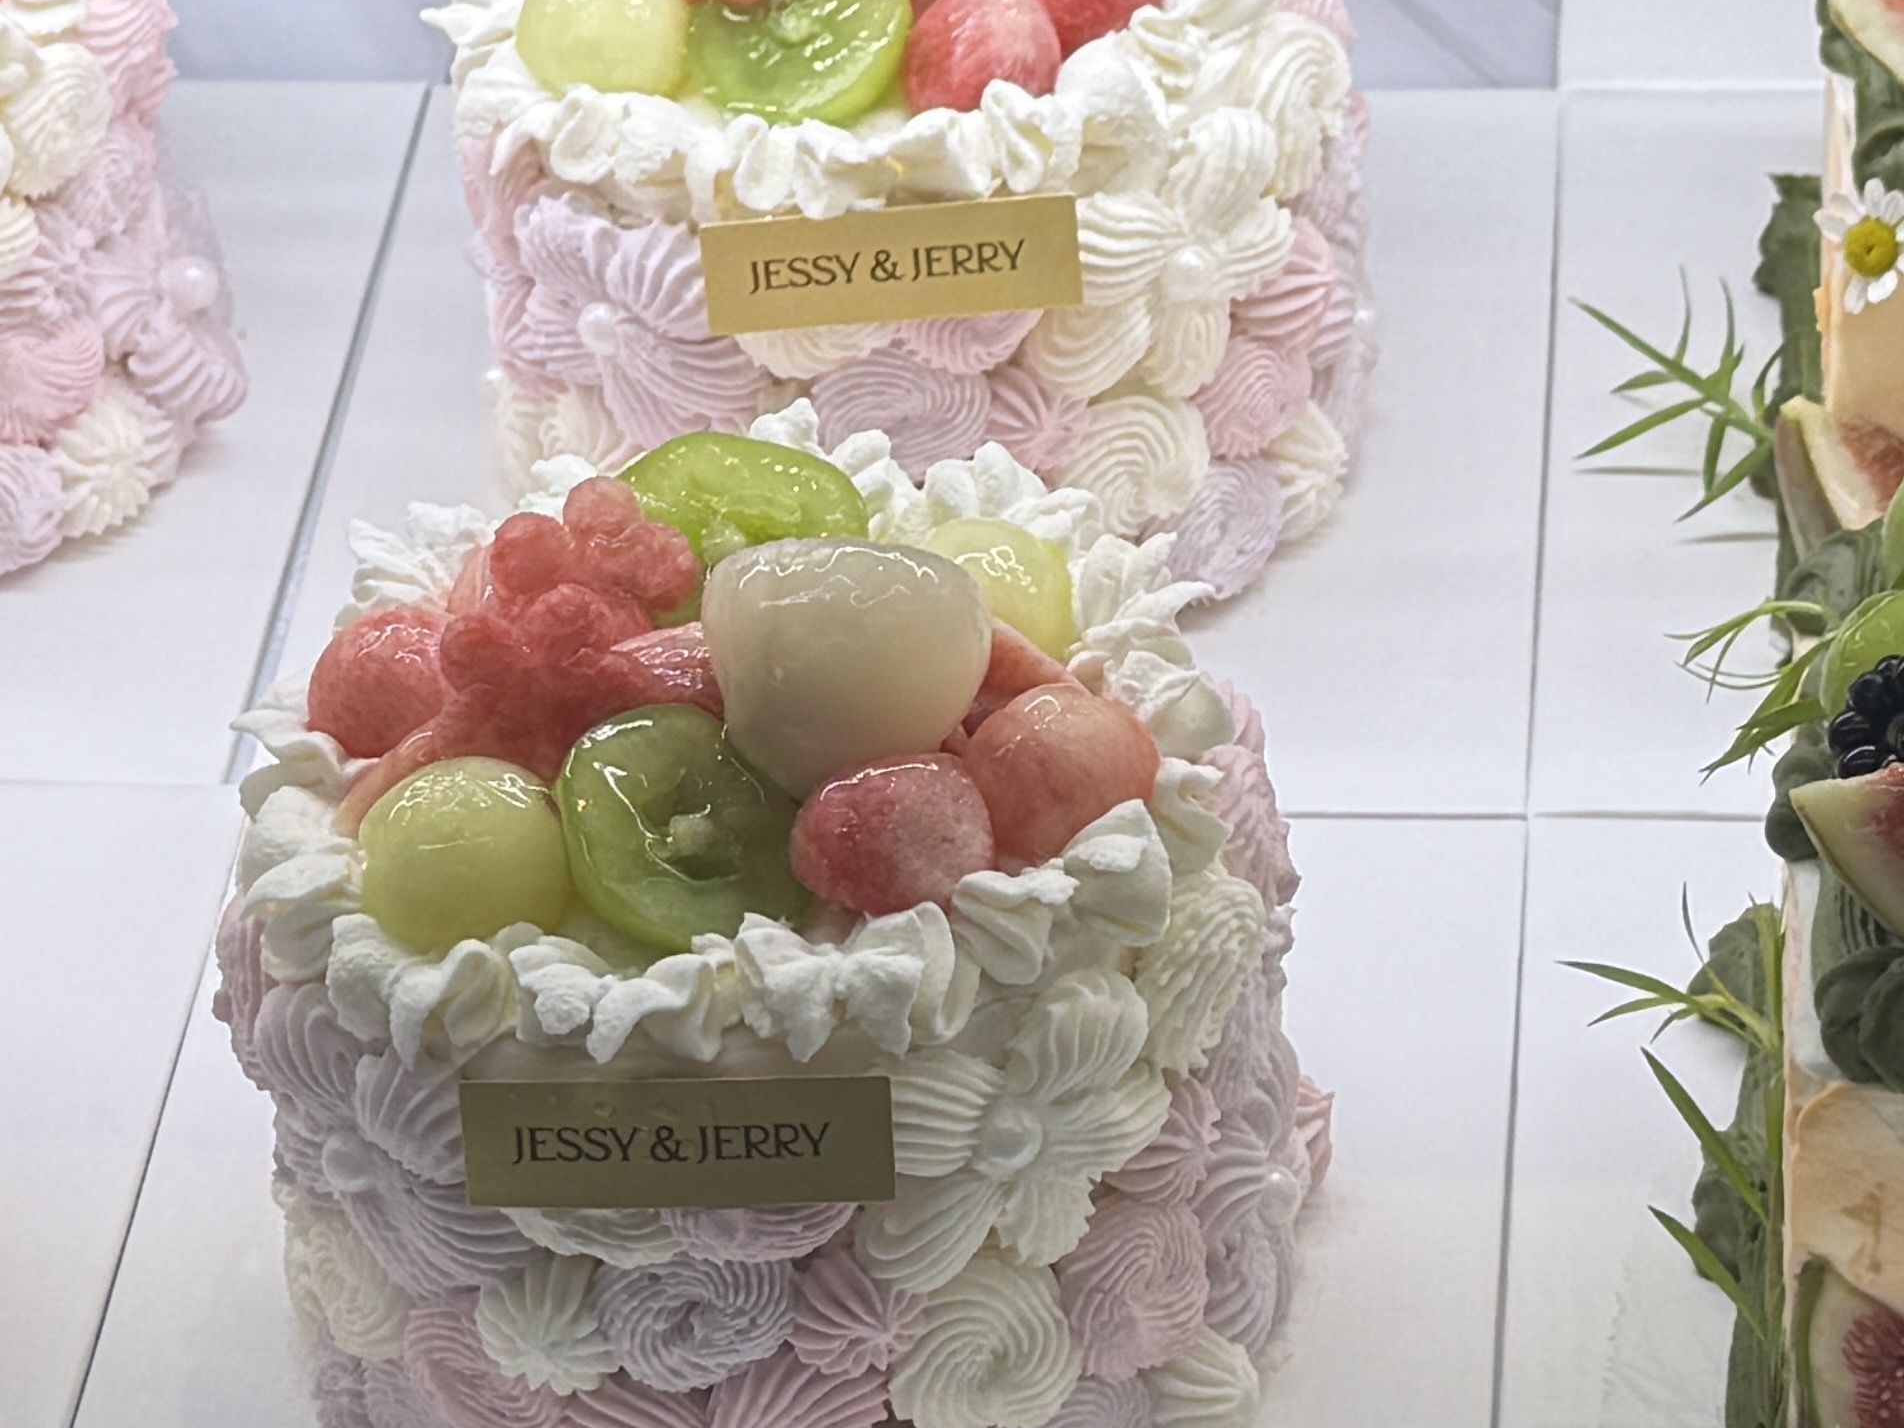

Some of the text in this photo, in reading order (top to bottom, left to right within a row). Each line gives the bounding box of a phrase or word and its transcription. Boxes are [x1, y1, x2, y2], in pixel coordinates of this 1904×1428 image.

[749, 238, 1025, 294] JESSY & JERRY
[512, 1121, 830, 1166] JESSY & JERRY
